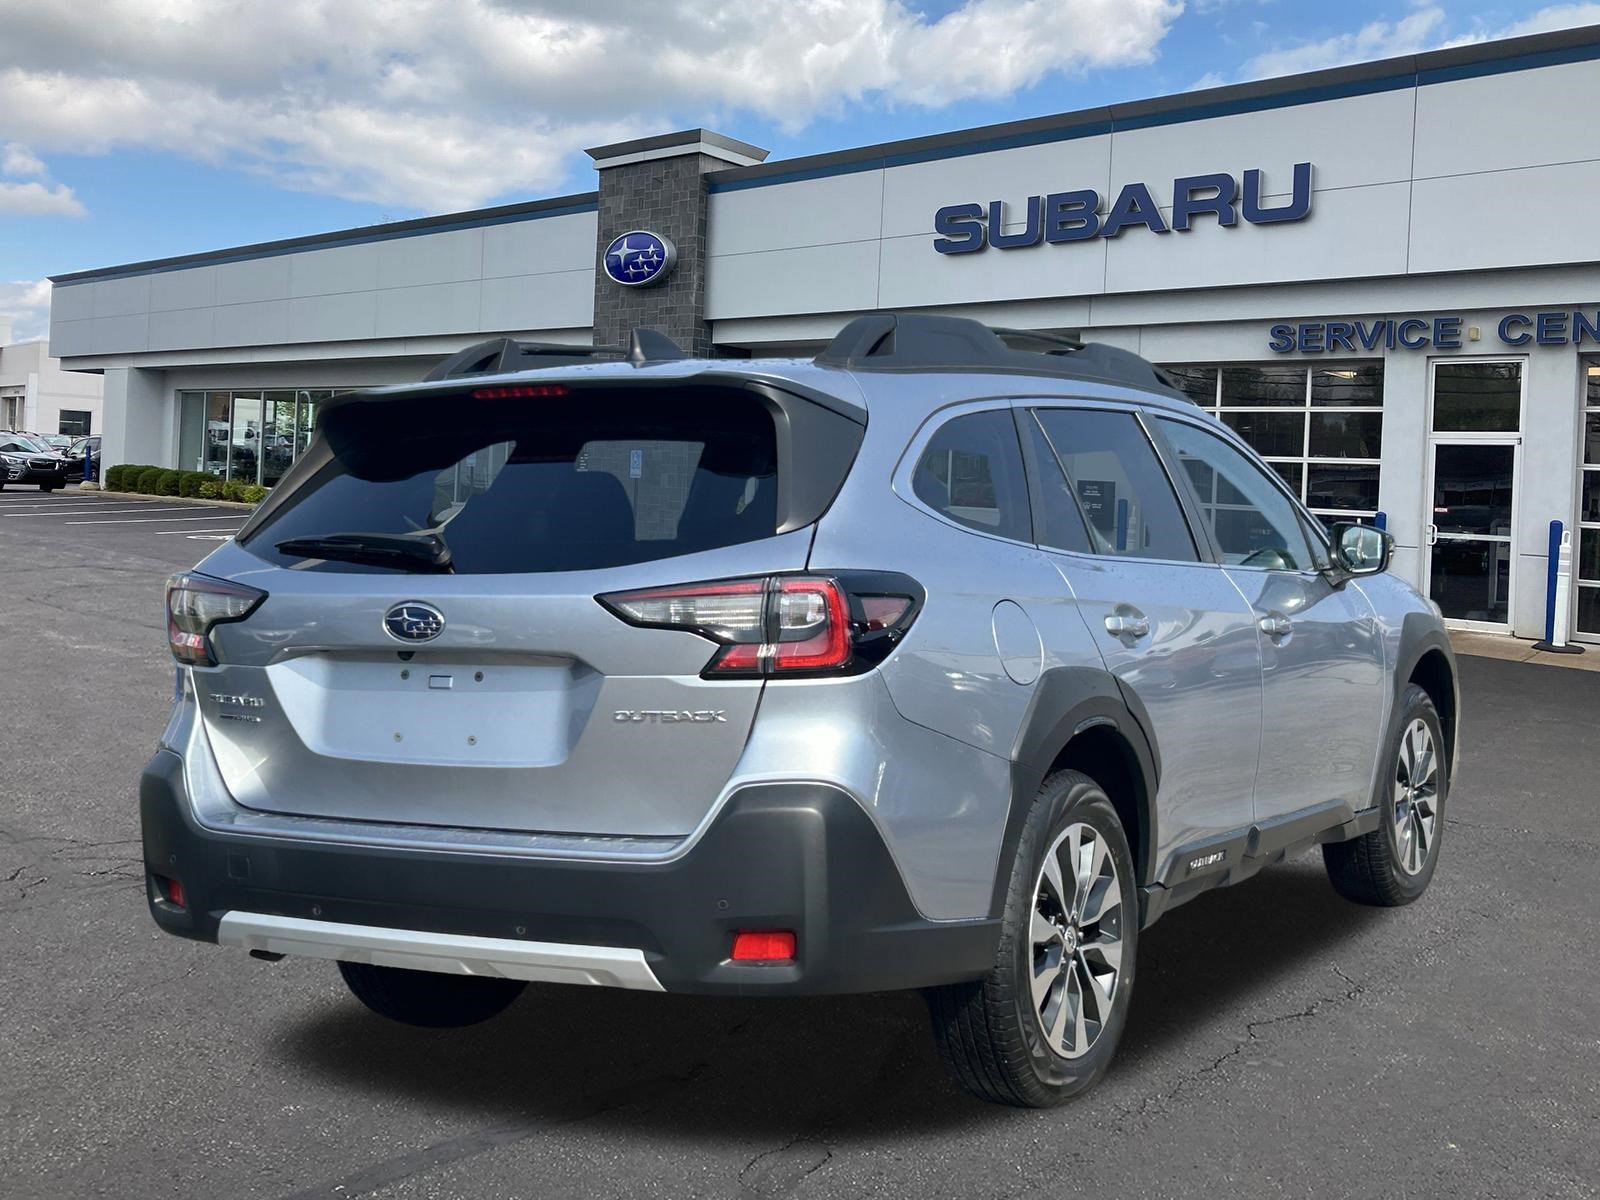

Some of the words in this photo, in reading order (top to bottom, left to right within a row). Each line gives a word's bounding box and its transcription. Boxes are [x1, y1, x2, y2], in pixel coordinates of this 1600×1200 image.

[933, 161, 1314, 255] SUBARU
[1268, 317, 1463, 353] SERVICE
[1497, 309, 1600, 347] CEN
[613, 709, 728, 724] OUTBACK
